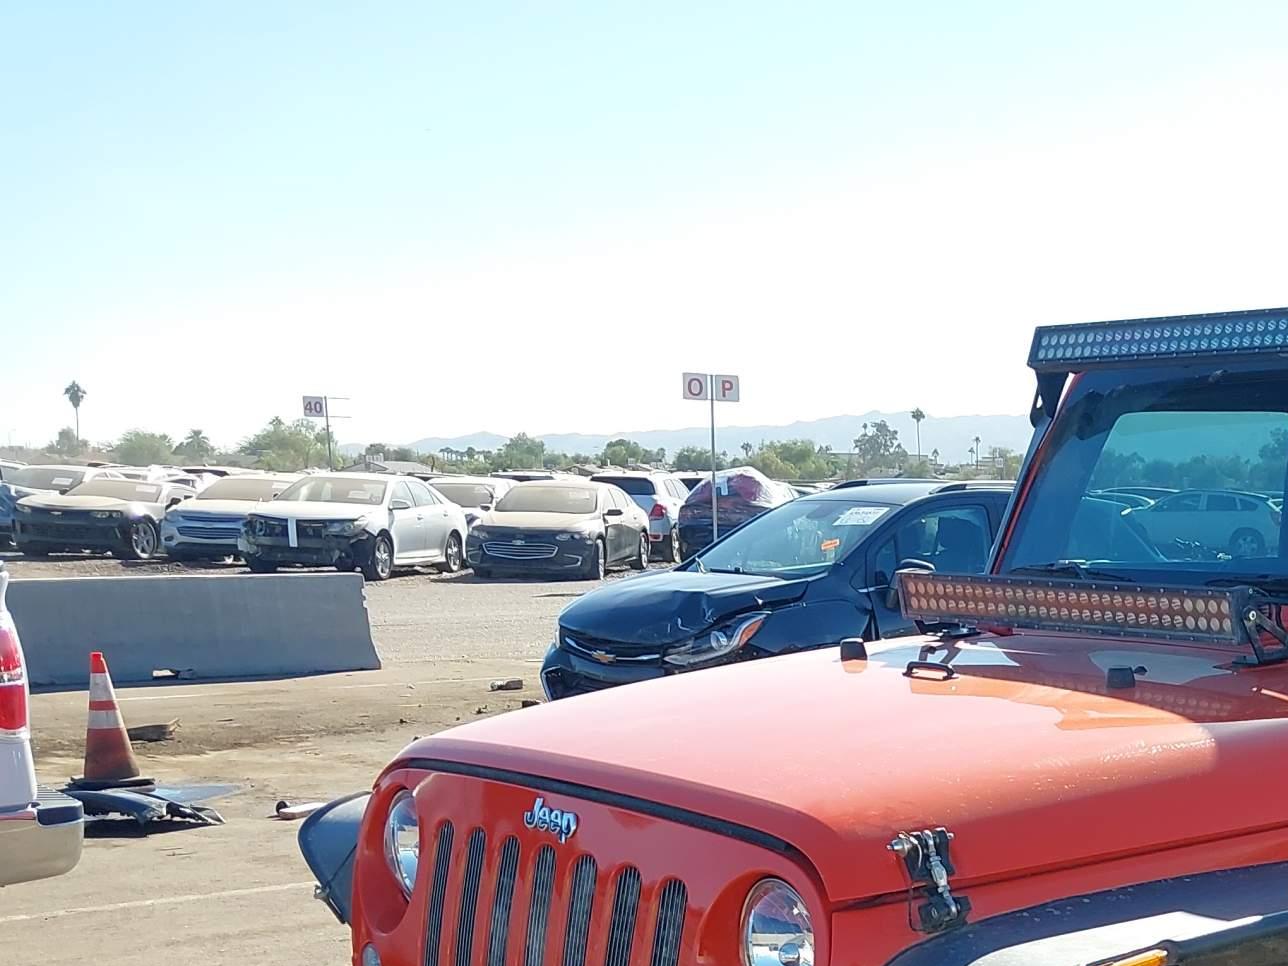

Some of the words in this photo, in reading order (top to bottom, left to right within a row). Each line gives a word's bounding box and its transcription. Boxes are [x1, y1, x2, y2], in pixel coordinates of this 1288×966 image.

[688, 378, 703, 396] O
[722, 380, 733, 398] P
[305, 401, 322, 413] 40
[524, 797, 578, 845] Jeep
